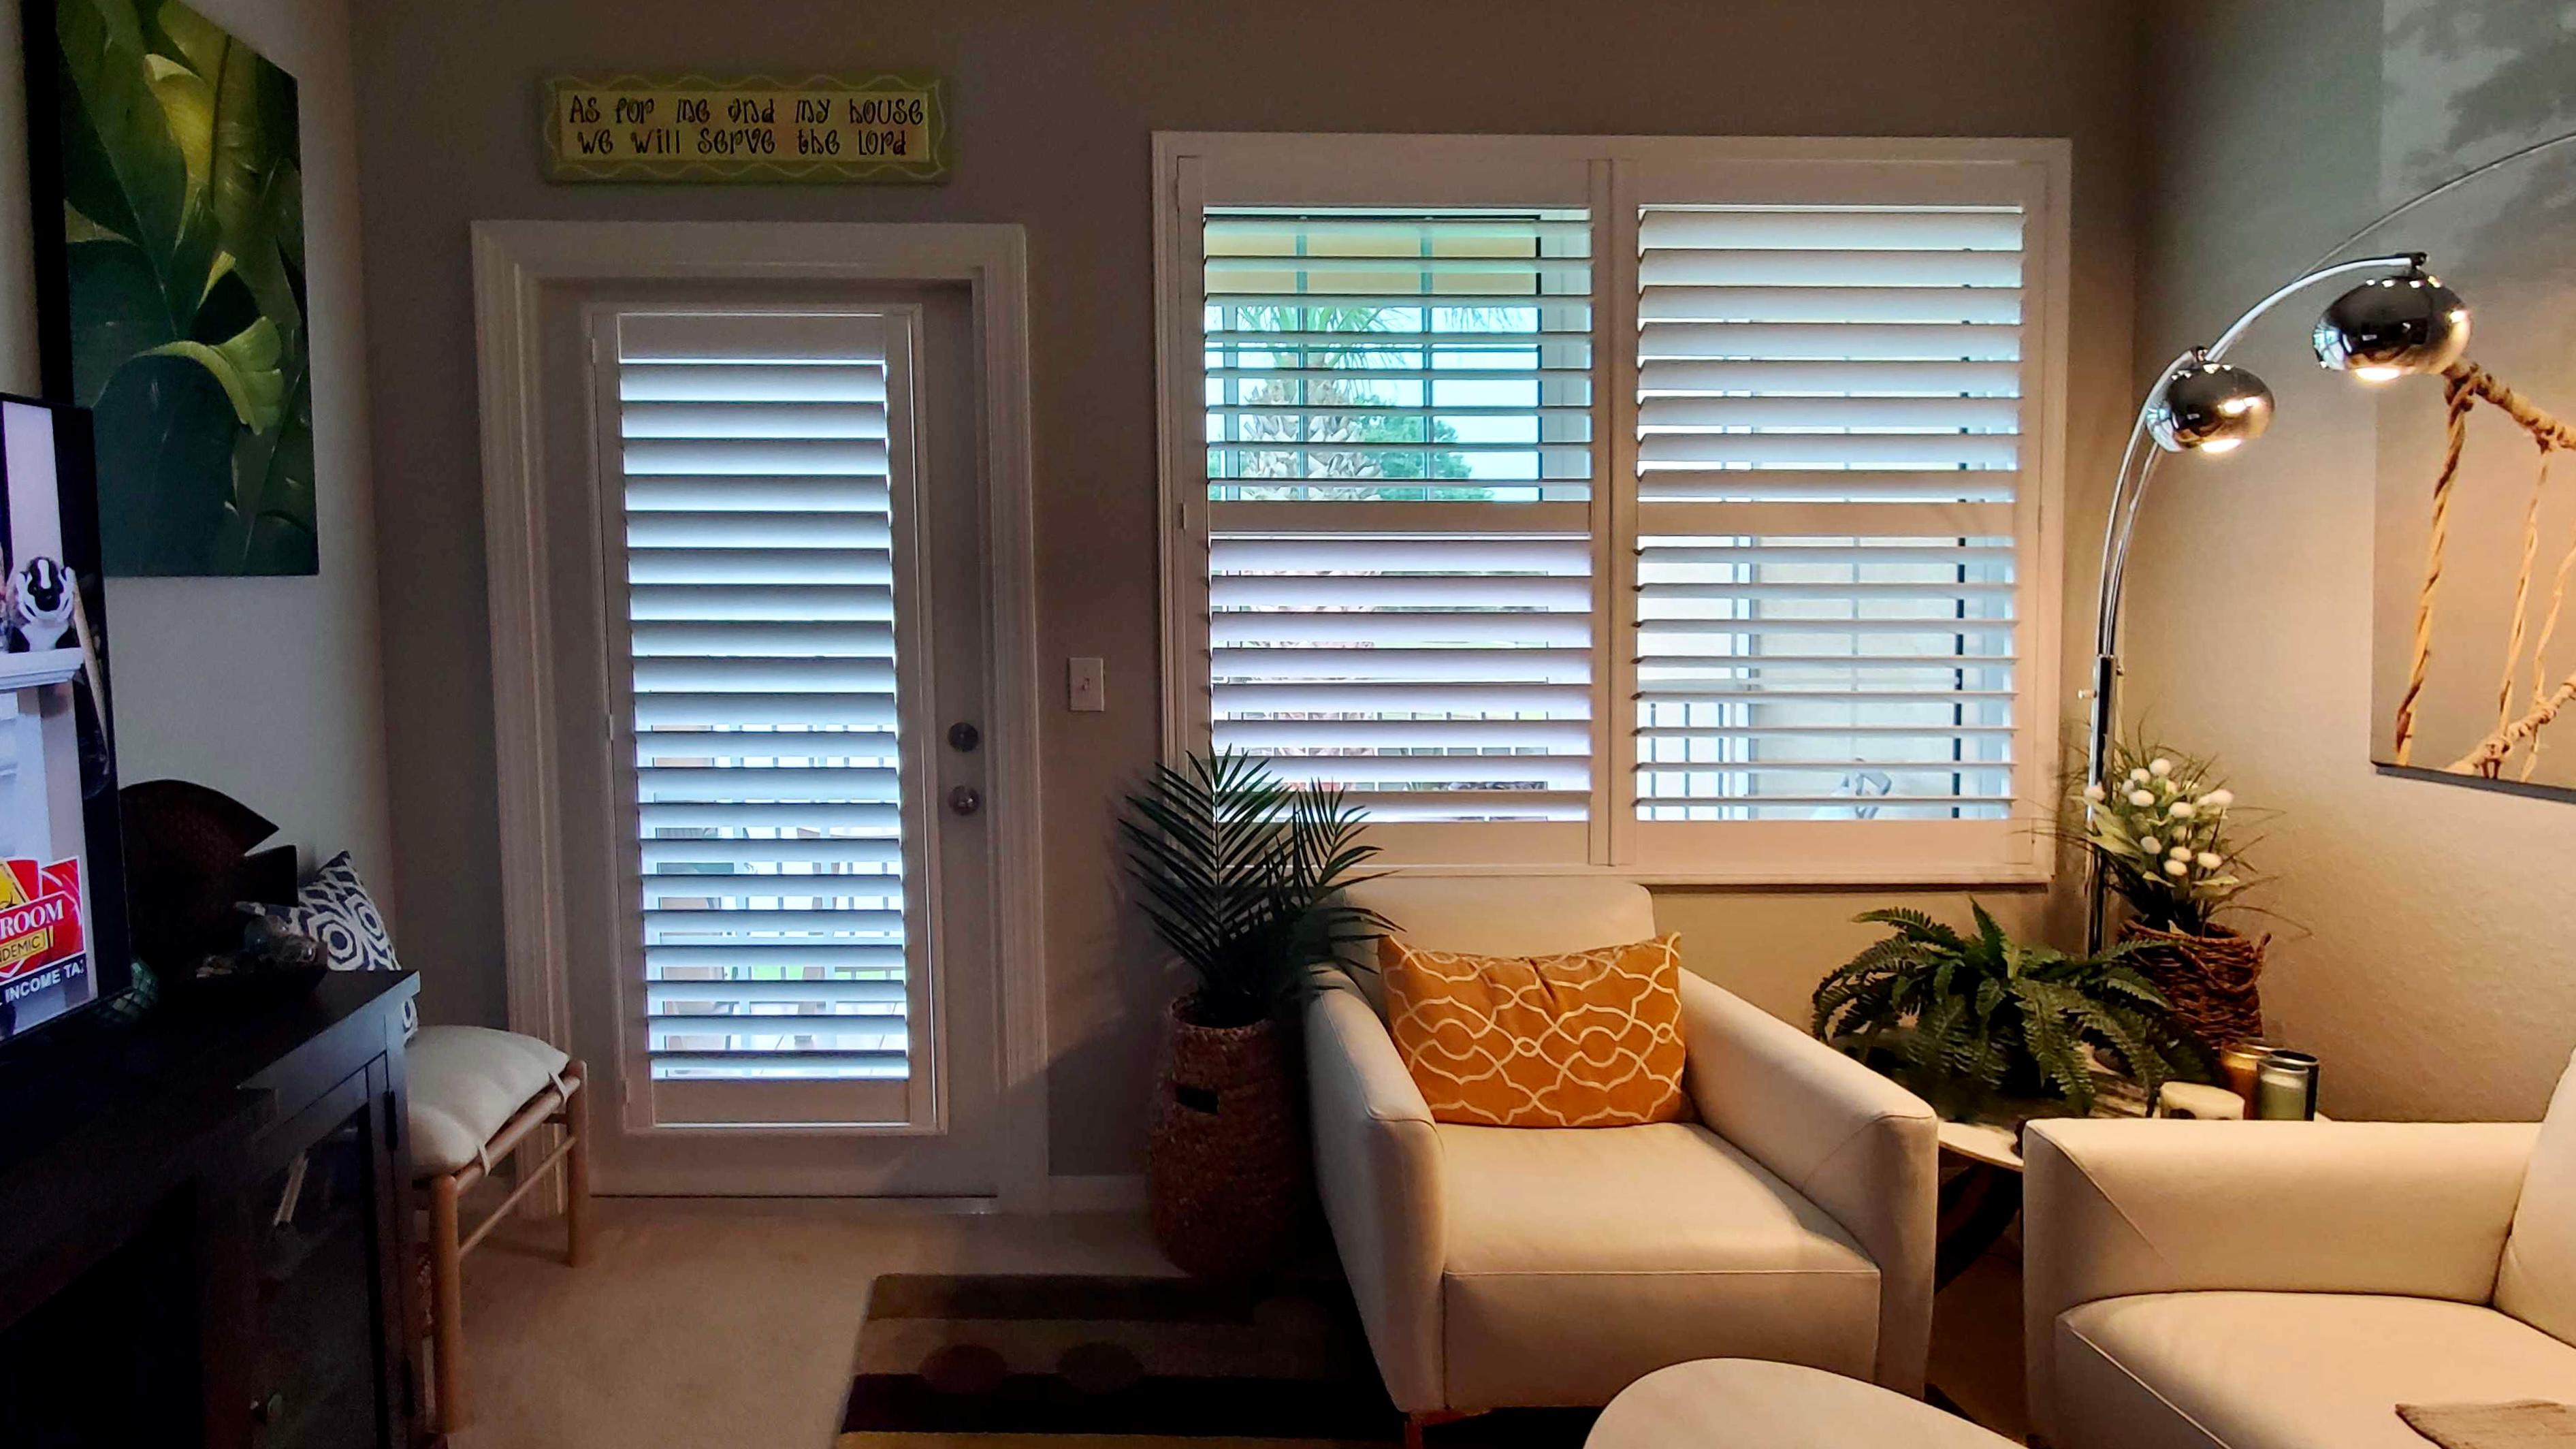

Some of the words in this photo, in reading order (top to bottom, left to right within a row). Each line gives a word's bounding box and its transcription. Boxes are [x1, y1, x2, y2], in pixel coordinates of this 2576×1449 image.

[615, 97, 655, 125] for
[676, 99, 711, 124] me
[727, 98, 775, 124] and
[794, 98, 831, 124] my
[849, 98, 924, 125] house
[577, 129, 613, 155] we
[630, 128, 680, 155] will
[697, 127, 775, 155] serve
[797, 128, 840, 155] the
[0, 936, 41, 962] DEMIC
[5, 968, 61, 1003] INCOME
